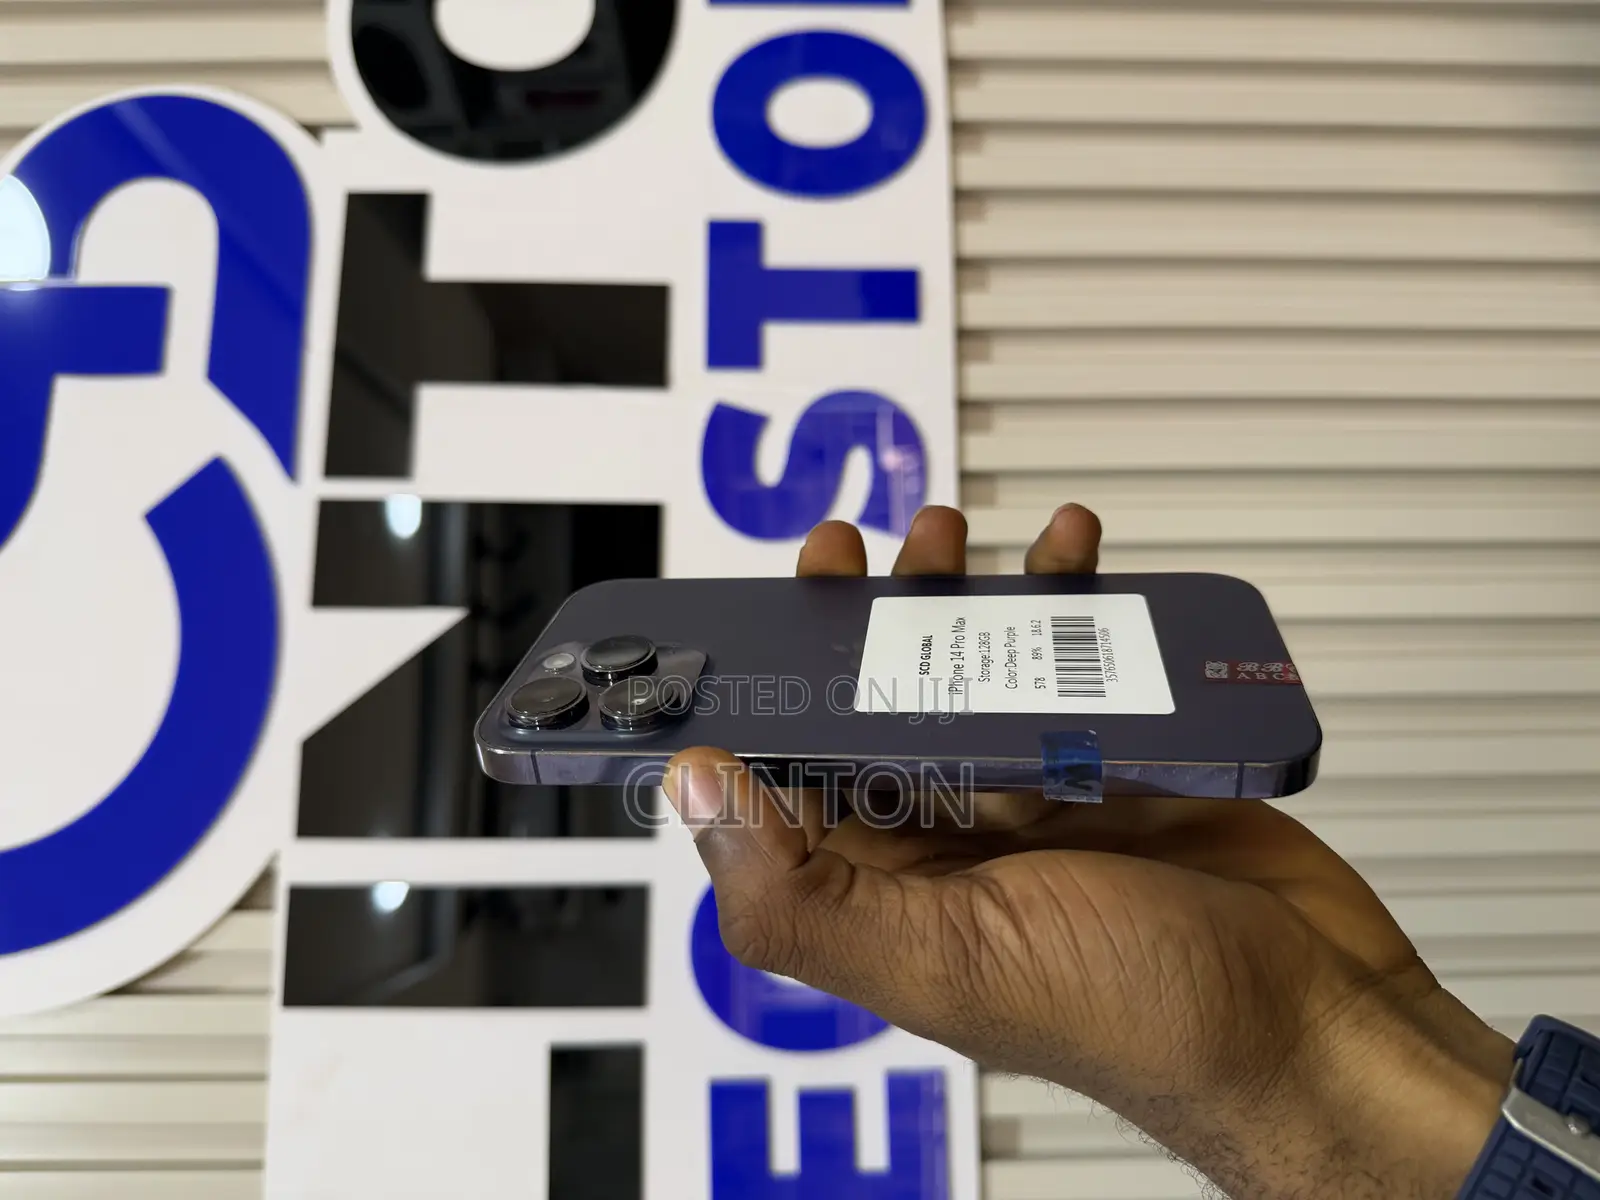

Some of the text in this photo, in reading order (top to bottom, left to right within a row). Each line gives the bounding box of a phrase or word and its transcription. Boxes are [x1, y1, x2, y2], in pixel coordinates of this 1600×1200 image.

[699, 0, 928, 541] STO
[919, 634, 933, 676] SCD GLOBAL
[948, 617, 967, 695] iPhone 14 Pro Max
[978, 631, 995, 682] Storage:128GB
[1004, 626, 1020, 689] Color:Deep Purple
[1030, 619, 1046, 689] 578 89% 18.6.2
[1098, 627, 1118, 682] 357650618714506
